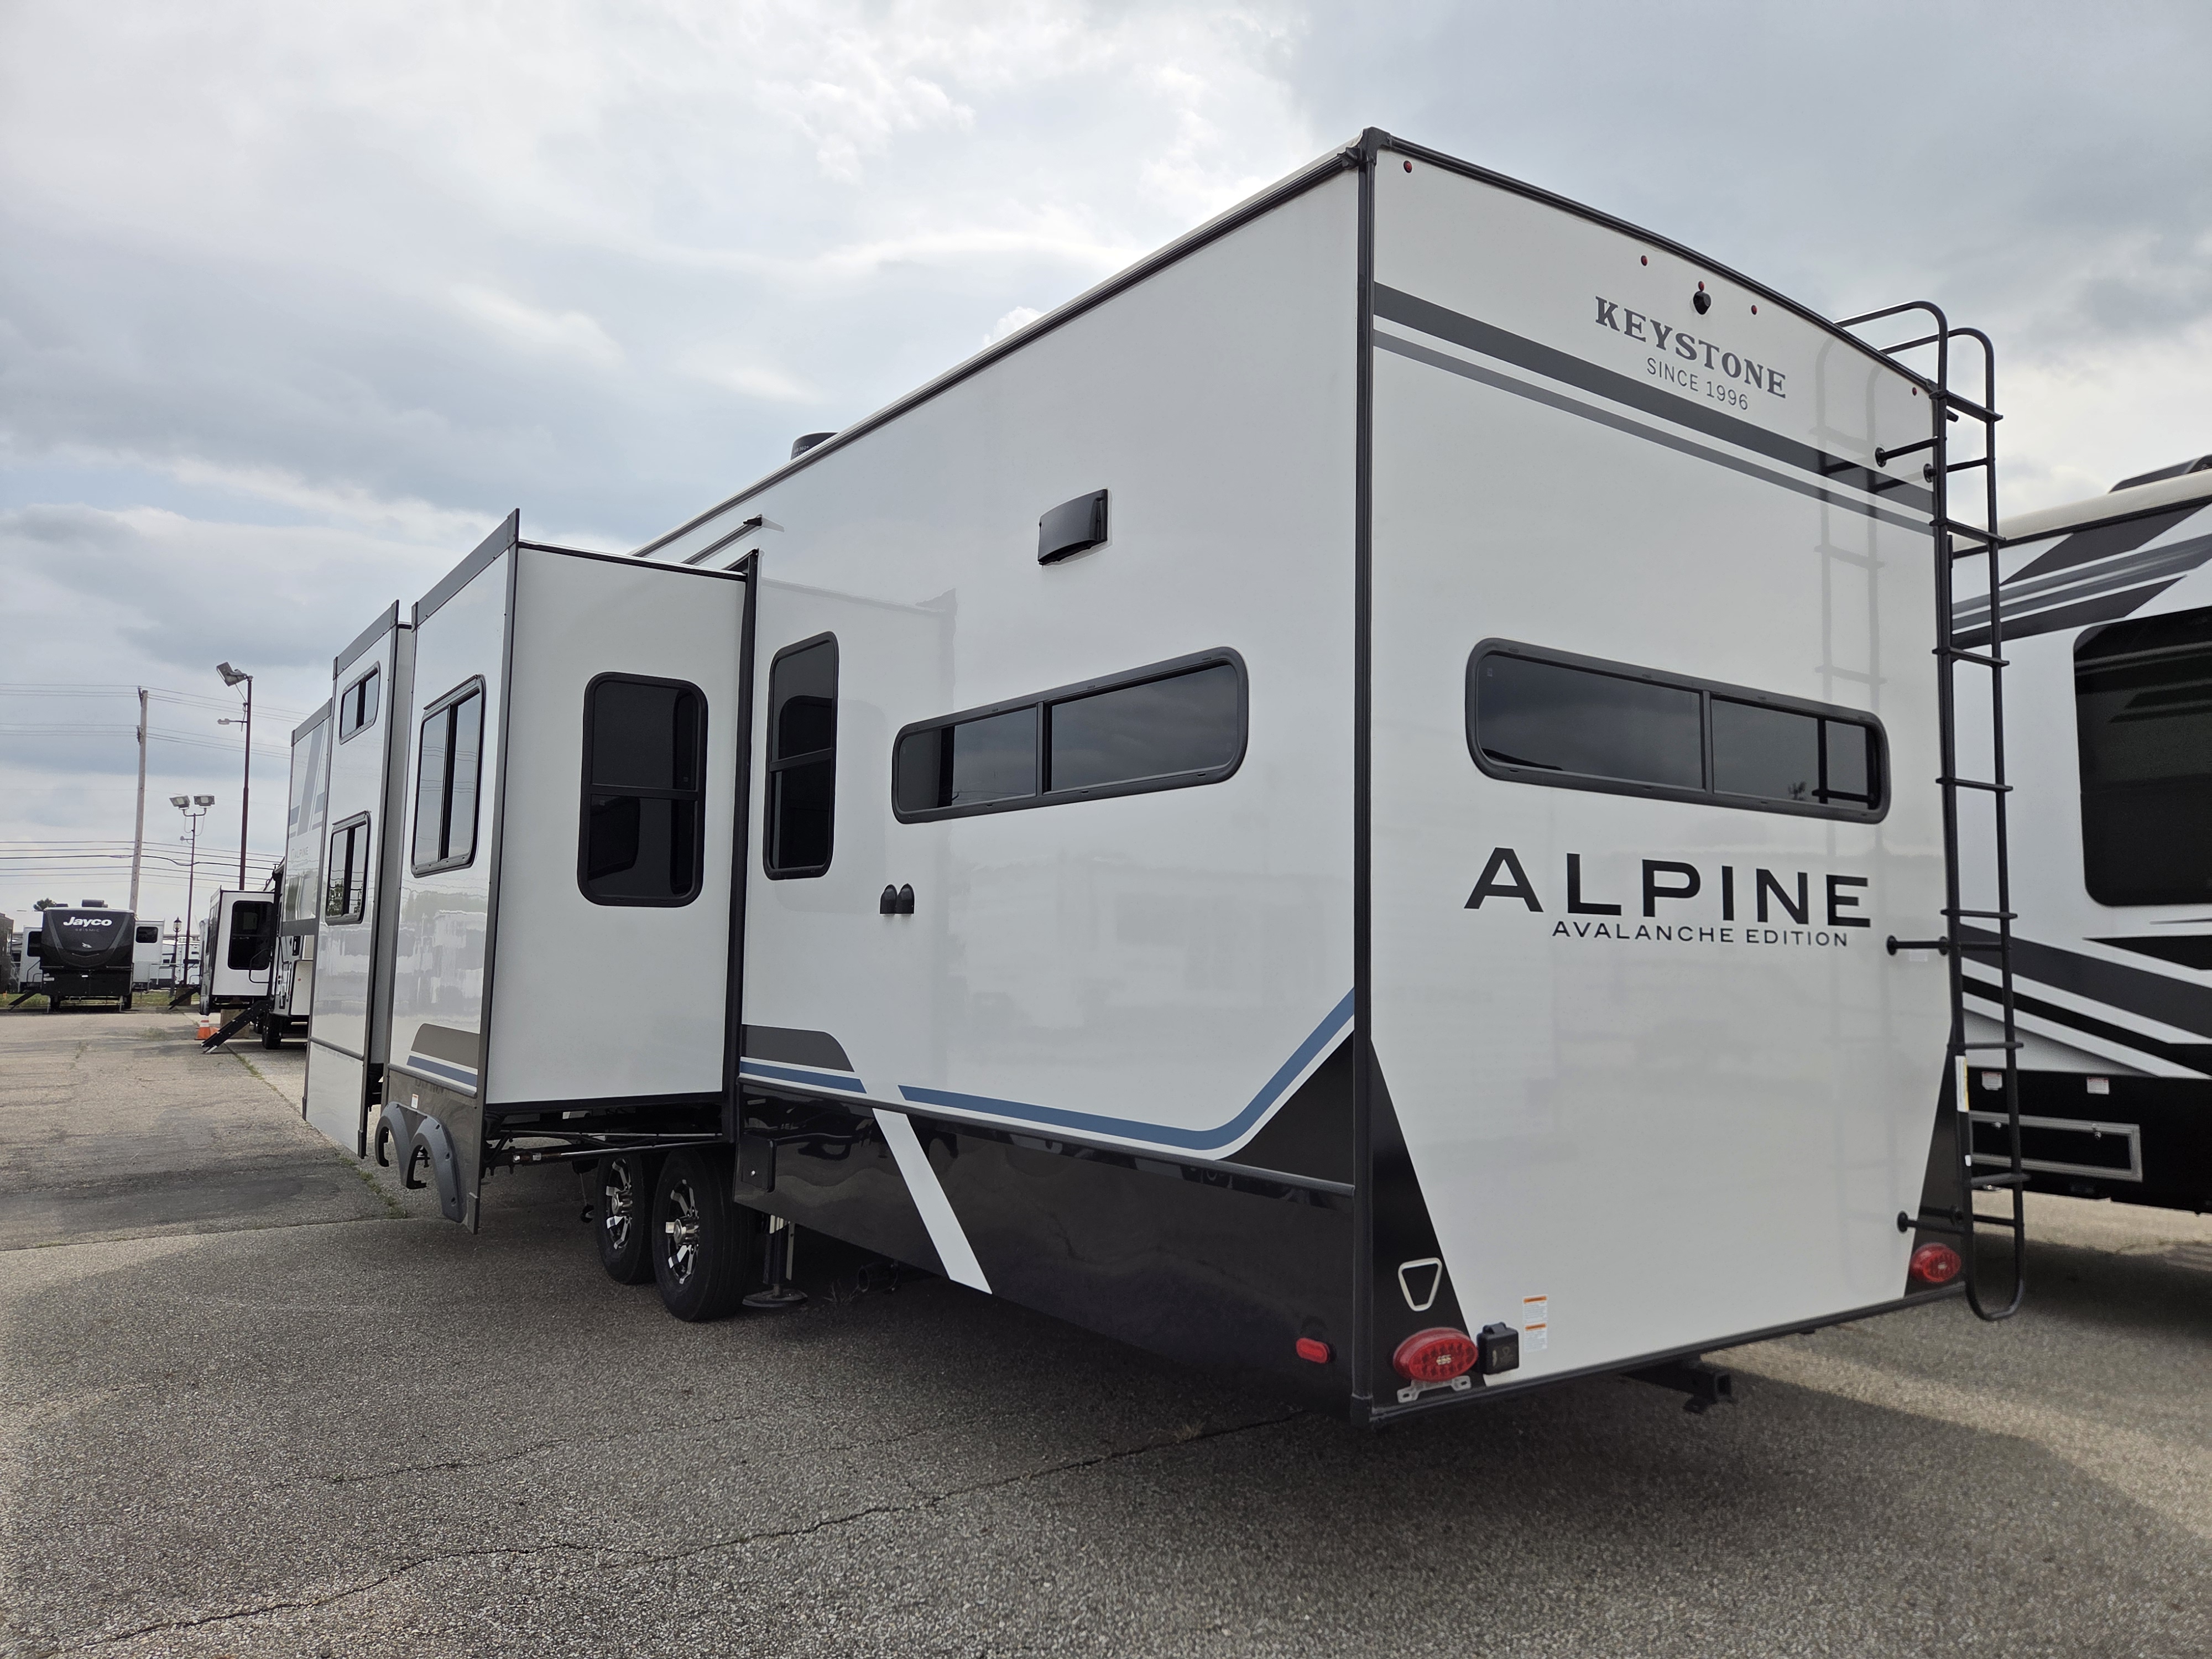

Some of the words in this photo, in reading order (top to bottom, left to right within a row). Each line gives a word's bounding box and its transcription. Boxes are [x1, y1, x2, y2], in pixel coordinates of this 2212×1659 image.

[1595, 295, 1786, 399] KEYSTONE
[1646, 357, 1699, 392] SINCE
[1706, 380, 1749, 410] 1996
[1463, 847, 1871, 928] ALPINE
[63, 916, 112, 927] Jayco
[1552, 921, 1734, 943] AVALANCHE
[1746, 929, 1848, 947] EDITION
